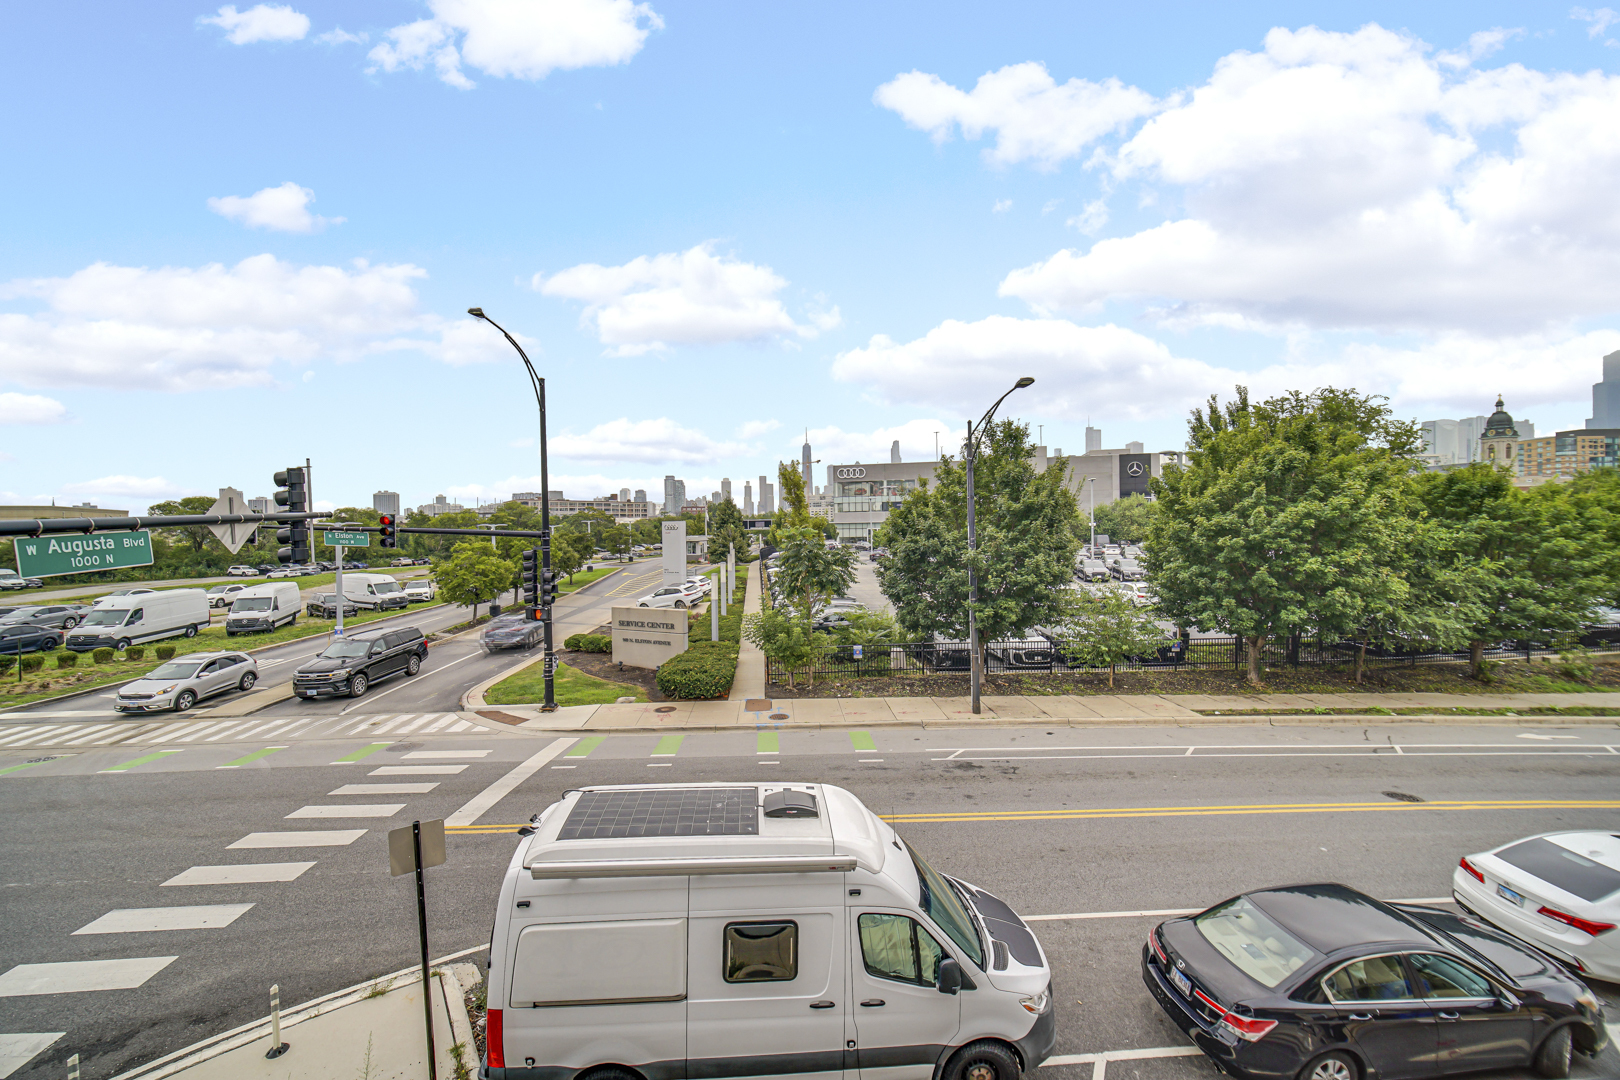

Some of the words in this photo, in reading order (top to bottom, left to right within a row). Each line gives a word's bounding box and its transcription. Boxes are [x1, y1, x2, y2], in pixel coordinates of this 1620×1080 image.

[26, 545, 37, 556] W
[48, 536, 115, 555] Augusta
[123, 537, 145, 548] Blvd
[71, 555, 100, 567] 1000
[106, 554, 114, 564] N
